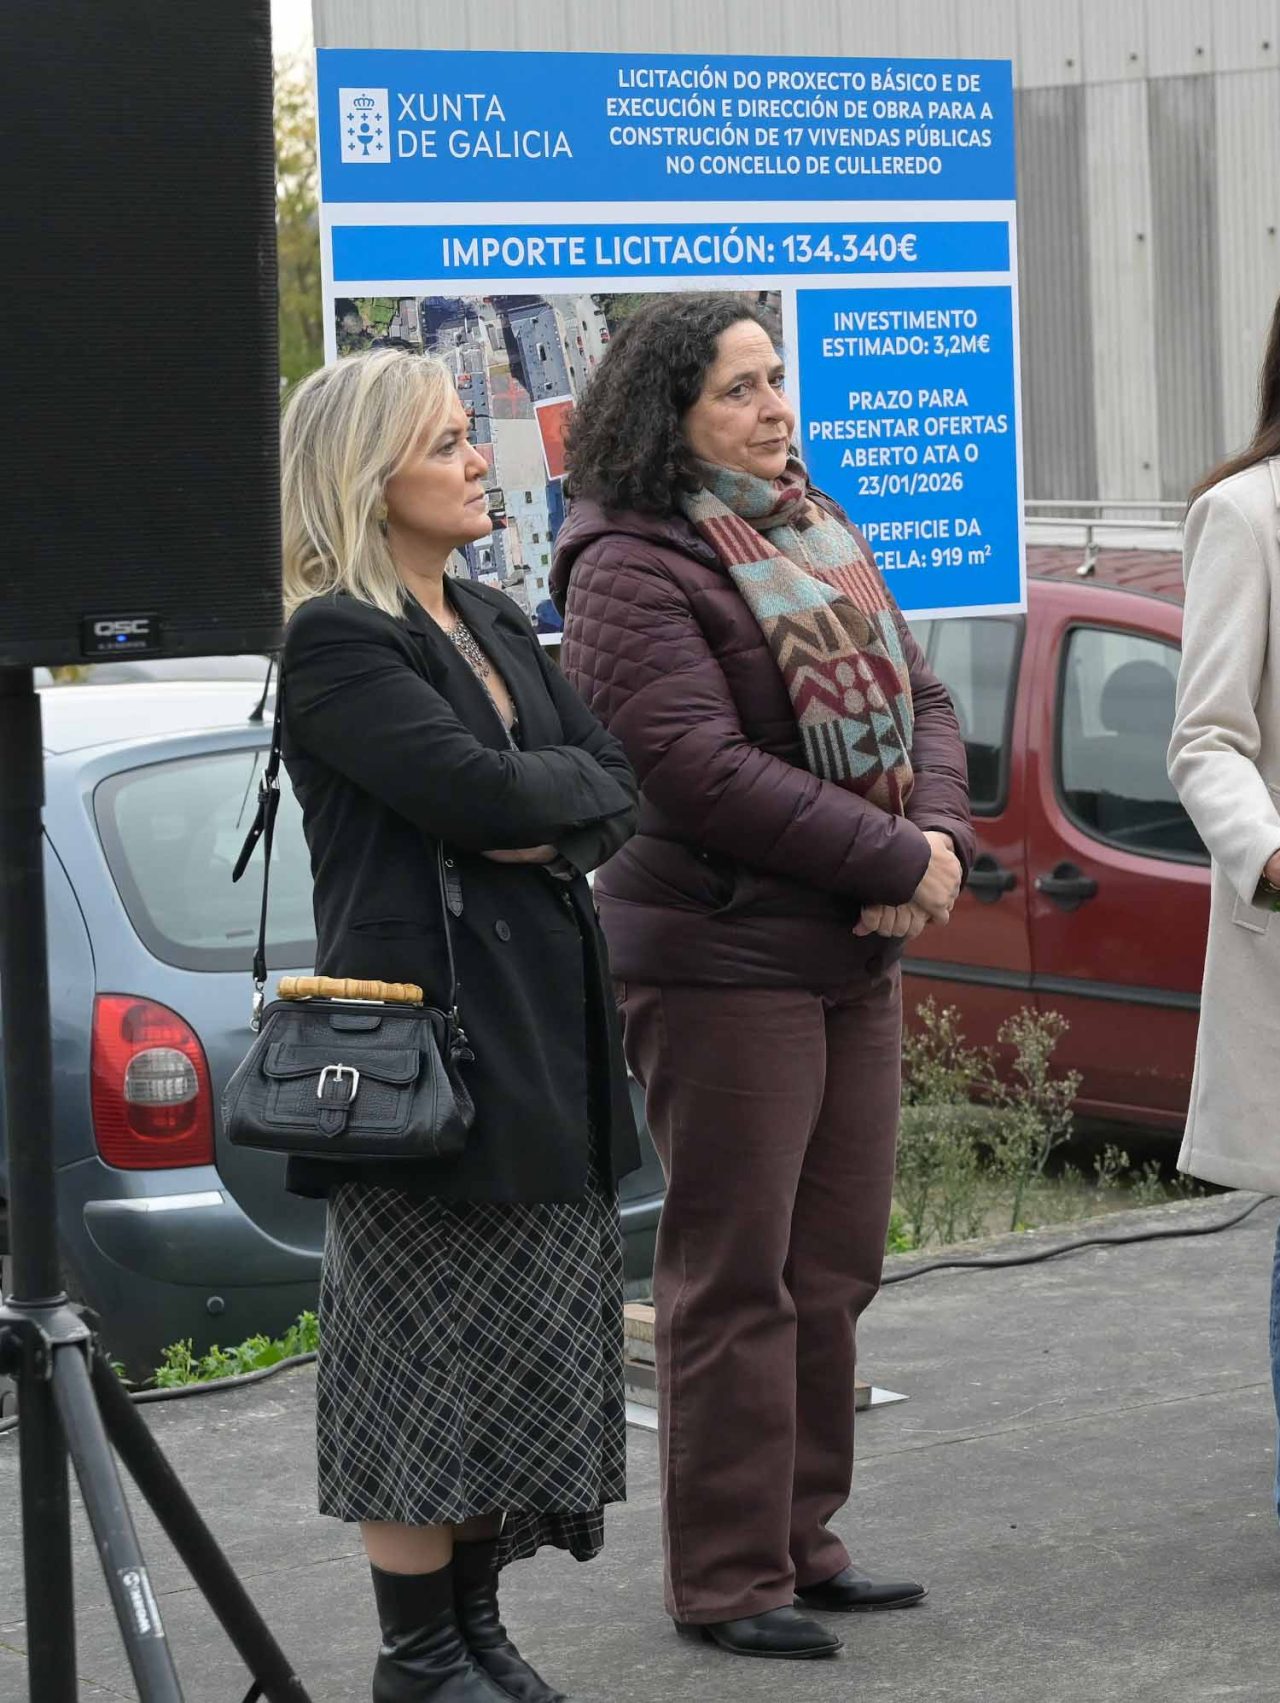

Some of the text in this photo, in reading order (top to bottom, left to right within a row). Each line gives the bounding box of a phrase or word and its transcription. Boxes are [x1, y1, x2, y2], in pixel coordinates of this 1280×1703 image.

[618, 65, 981, 93] LICITACIÓN DO PROXECTO BÁSICO E DE
[397, 93, 506, 122] XUNTA
[606, 92, 994, 120] EXECUCIÓN E DIRECCIÓN DE OBRA PARA A
[397, 129, 573, 159] DE GALICIA
[609, 122, 992, 148] CONSTRUCIÓN DE 17 VIVENDAS PÚBLICAS
[666, 155, 942, 175] NO CONCELLO DE CULLEREDO
[442, 226, 918, 267] IMPORTE LICITACIÓN: 134.340€
[833, 309, 978, 331] INVESTIMENTO
[822, 334, 990, 358] ESTIMADO: 3,2M€
[848, 388, 969, 411] PRAZO PARA
[809, 414, 1008, 440] PRESENTAR OFERTAS
[840, 443, 979, 468] ABERTO ATA O
[858, 471, 964, 497] 23/01/2026
[855, 518, 982, 542] PERFICIE DA
[874, 549, 927, 571] CELA:
[931, 547, 963, 567] 919
[94, 619, 150, 636] QSC
